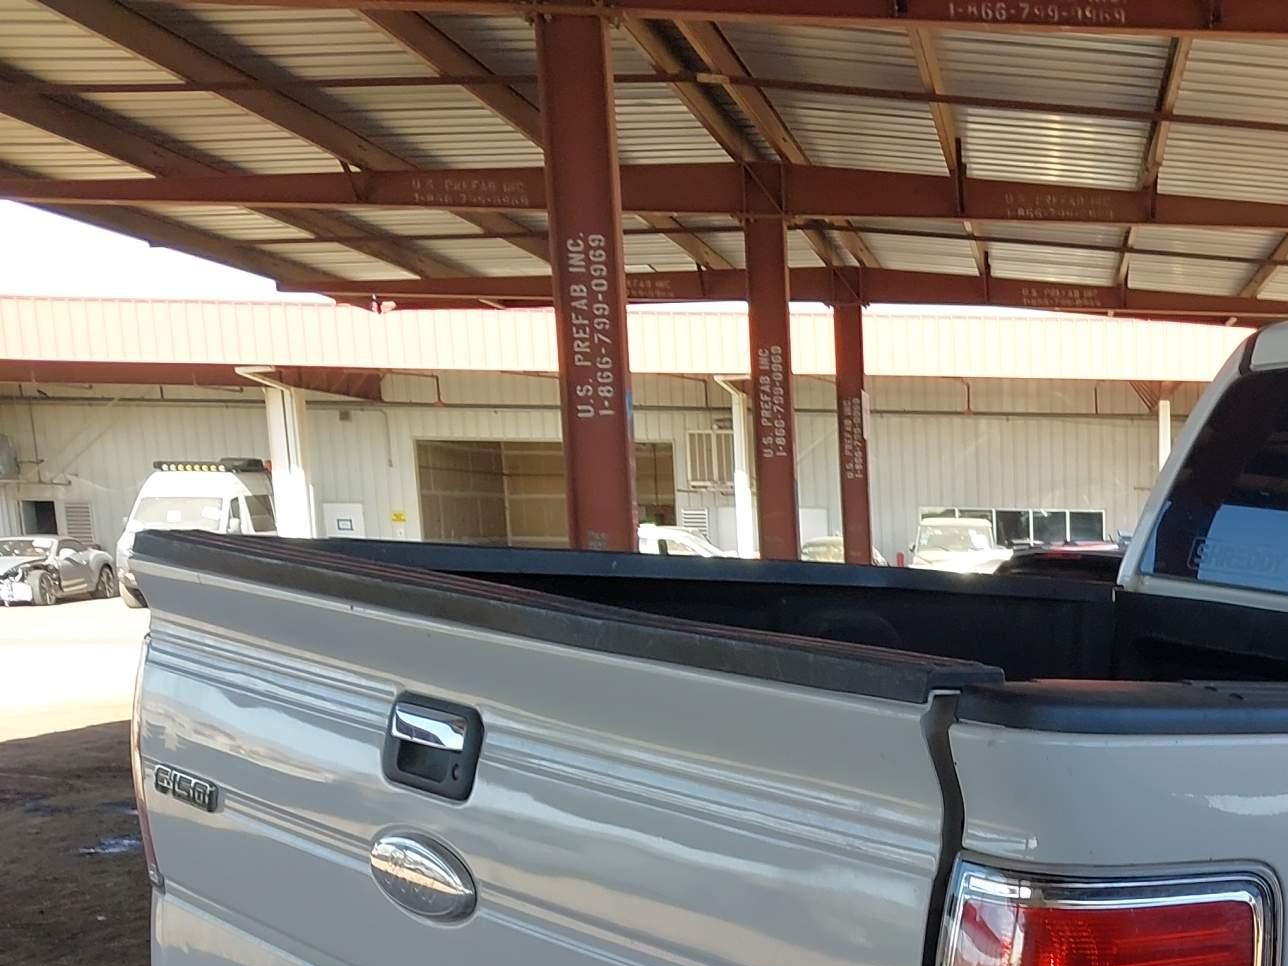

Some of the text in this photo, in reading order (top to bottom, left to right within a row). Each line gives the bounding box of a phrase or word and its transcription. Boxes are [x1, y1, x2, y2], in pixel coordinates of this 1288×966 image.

[566, 232, 595, 419] U.S. PREFAB INC.
[588, 233, 616, 416] 1-866-799-0969
[759, 375, 773, 427] PREFAB
[770, 345, 788, 457] 1-866-799-0969
